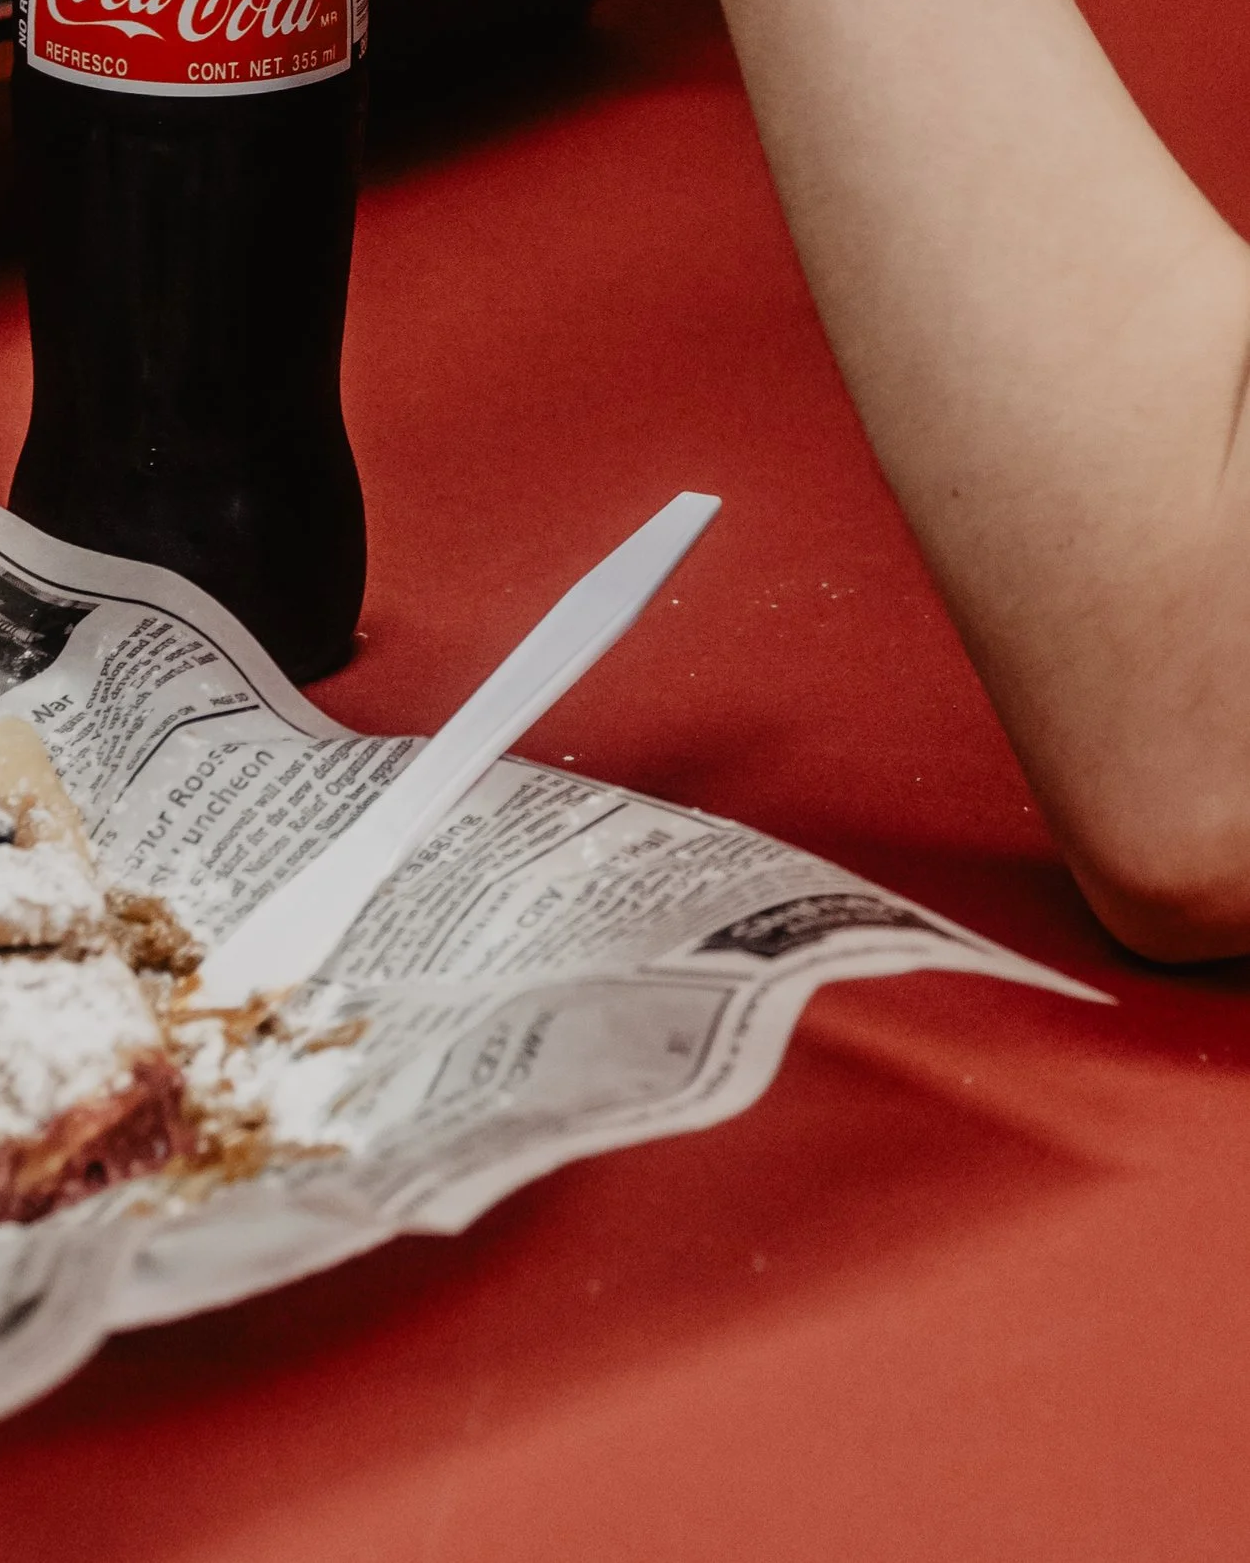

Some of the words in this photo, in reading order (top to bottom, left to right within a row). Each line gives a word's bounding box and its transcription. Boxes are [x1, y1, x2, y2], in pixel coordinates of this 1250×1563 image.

[17, 21, 28, 48] NO
[320, 11, 338, 28] MR
[46, 40, 128, 77] REFRESCO
[187, 60, 240, 81] CONT.
[250, 53, 285, 78] NET.
[292, 46, 317, 71] 355
[322, 44, 336, 64] ml
[126, 639, 150, 659] and
[146, 623, 173, 639] has
[174, 749, 275, 853] uncheon
